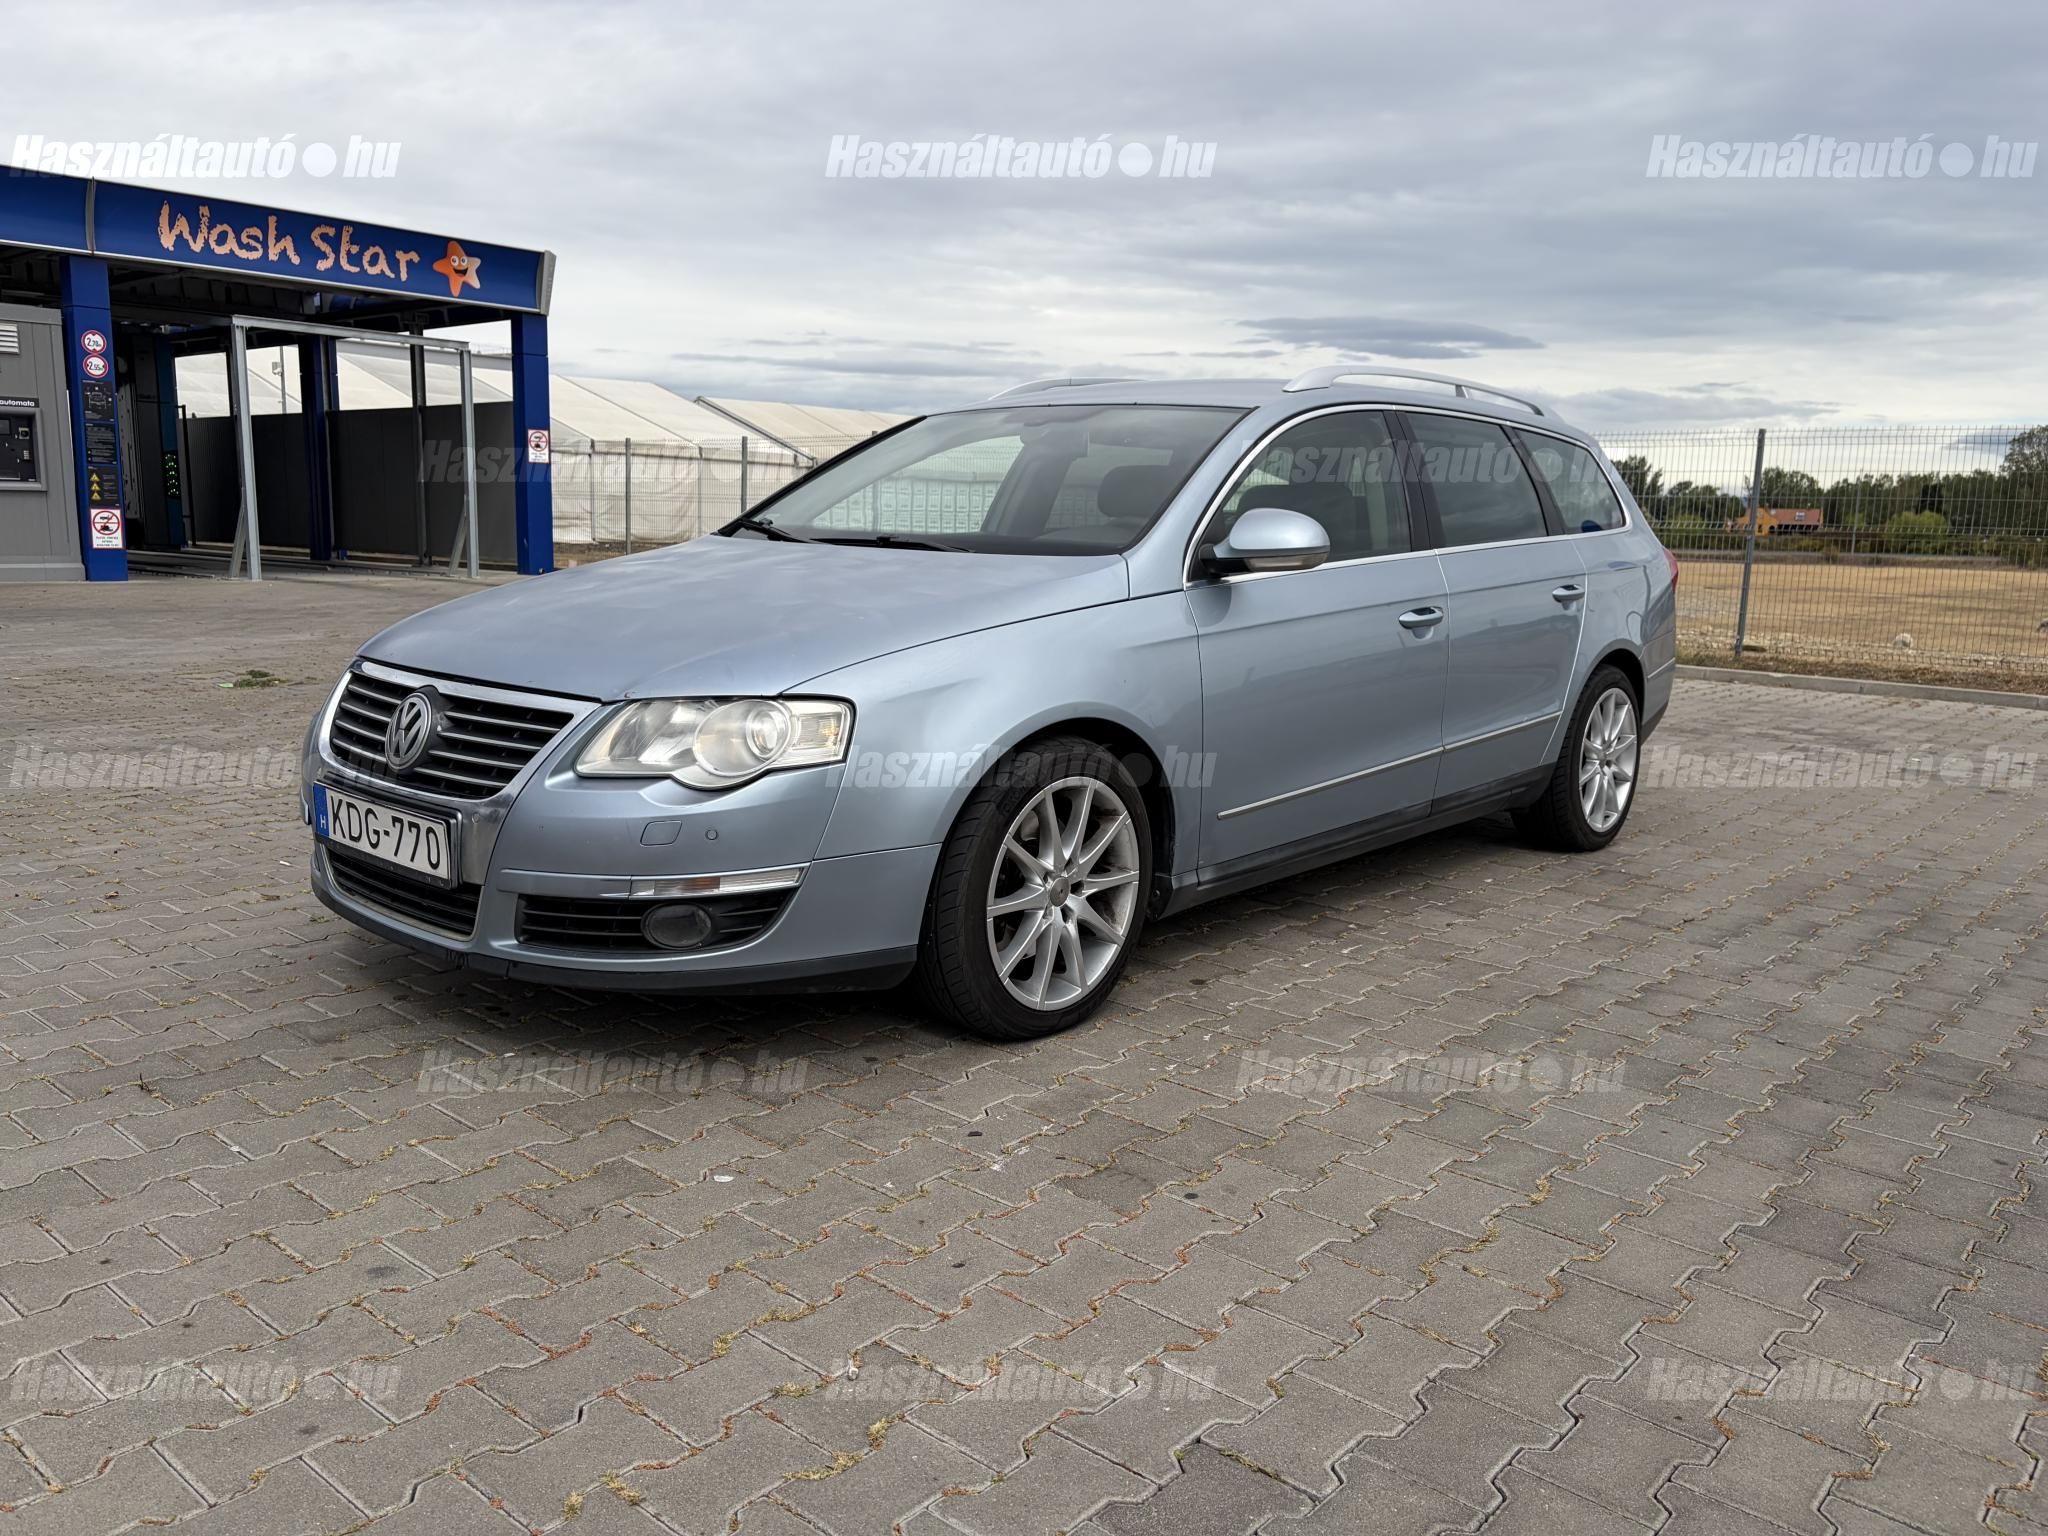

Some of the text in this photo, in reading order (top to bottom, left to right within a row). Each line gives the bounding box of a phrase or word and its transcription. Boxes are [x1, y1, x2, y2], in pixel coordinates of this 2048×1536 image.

[157, 200, 420, 281] Wash Star
[319, 814, 327, 830] H
[330, 795, 441, 870] KDG-770
